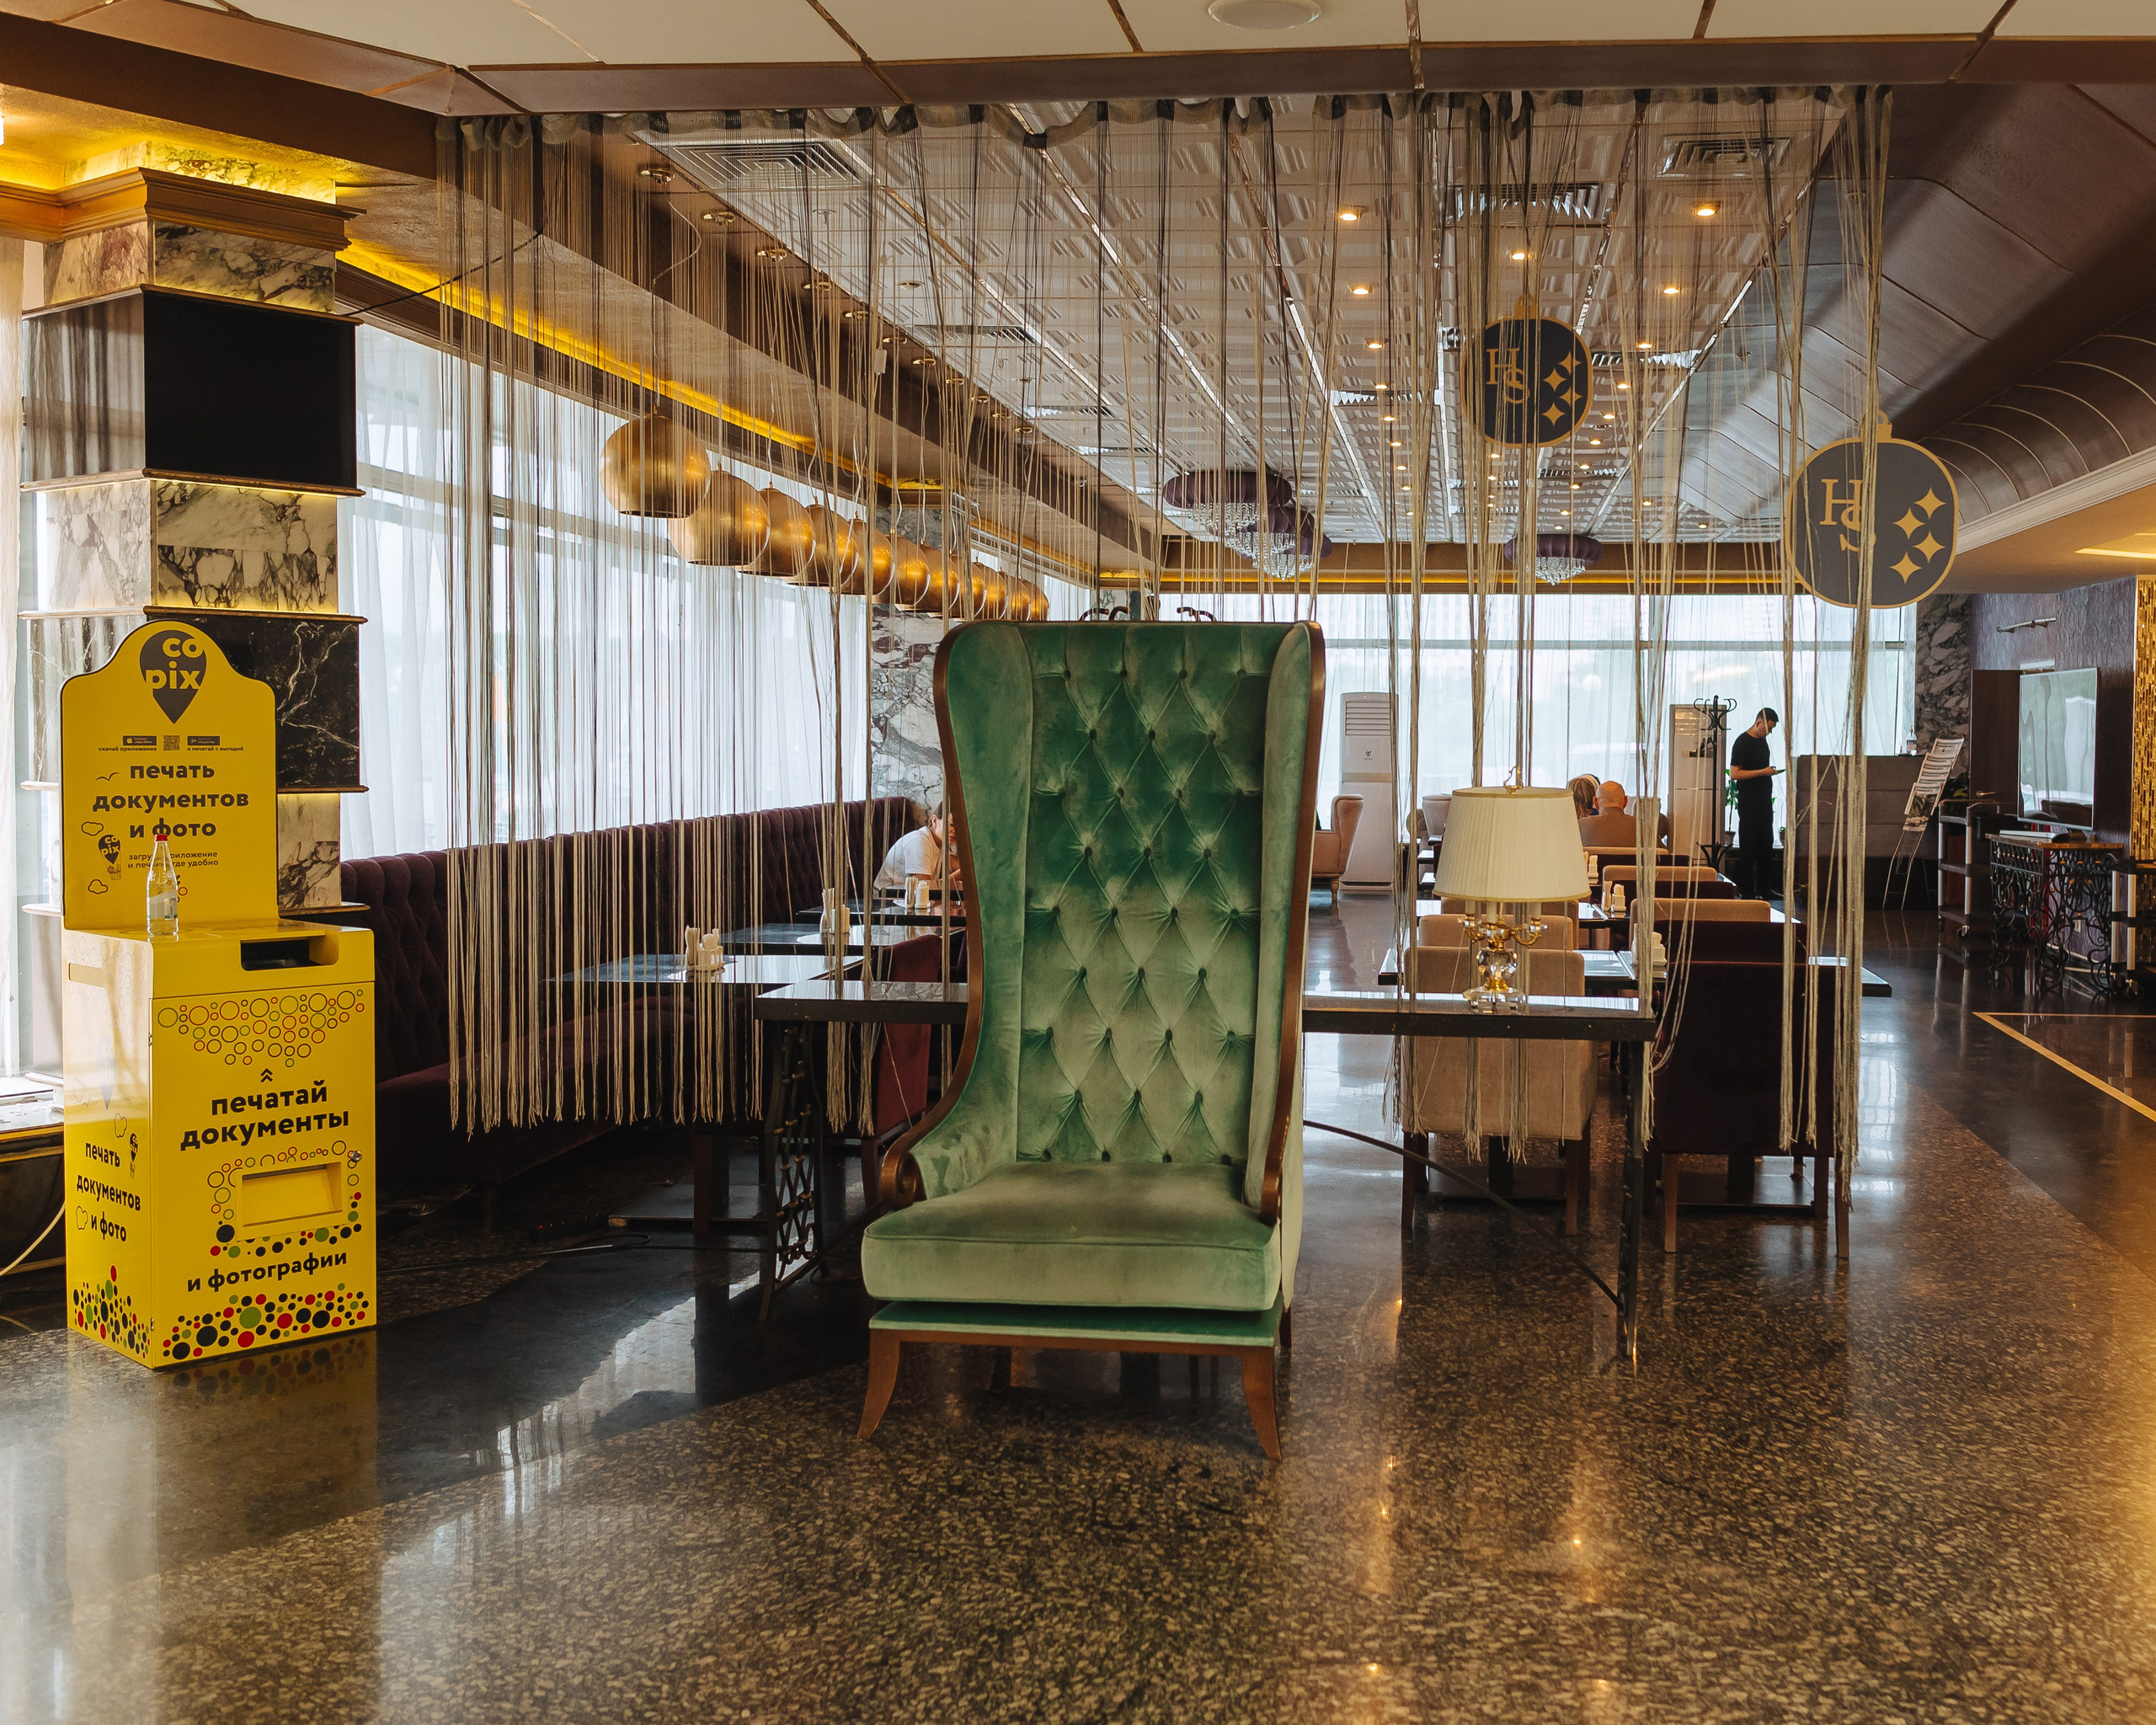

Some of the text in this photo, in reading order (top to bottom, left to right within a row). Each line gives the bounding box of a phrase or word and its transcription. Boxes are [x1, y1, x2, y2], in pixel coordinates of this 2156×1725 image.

[146, 660, 200, 690] pix
[130, 765, 215, 779] печать
[92, 793, 249, 814] документов
[130, 817, 217, 840] и фото
[168, 852, 218, 861] риложение
[187, 859, 219, 868] удобно
[211, 1079, 328, 1116] печатай
[179, 1110, 350, 1151] документы
[85, 1141, 120, 1167] печать
[76, 1174, 141, 1212] документов
[91, 1211, 127, 1242] и фото
[187, 1252, 347, 1293] и фотографии
